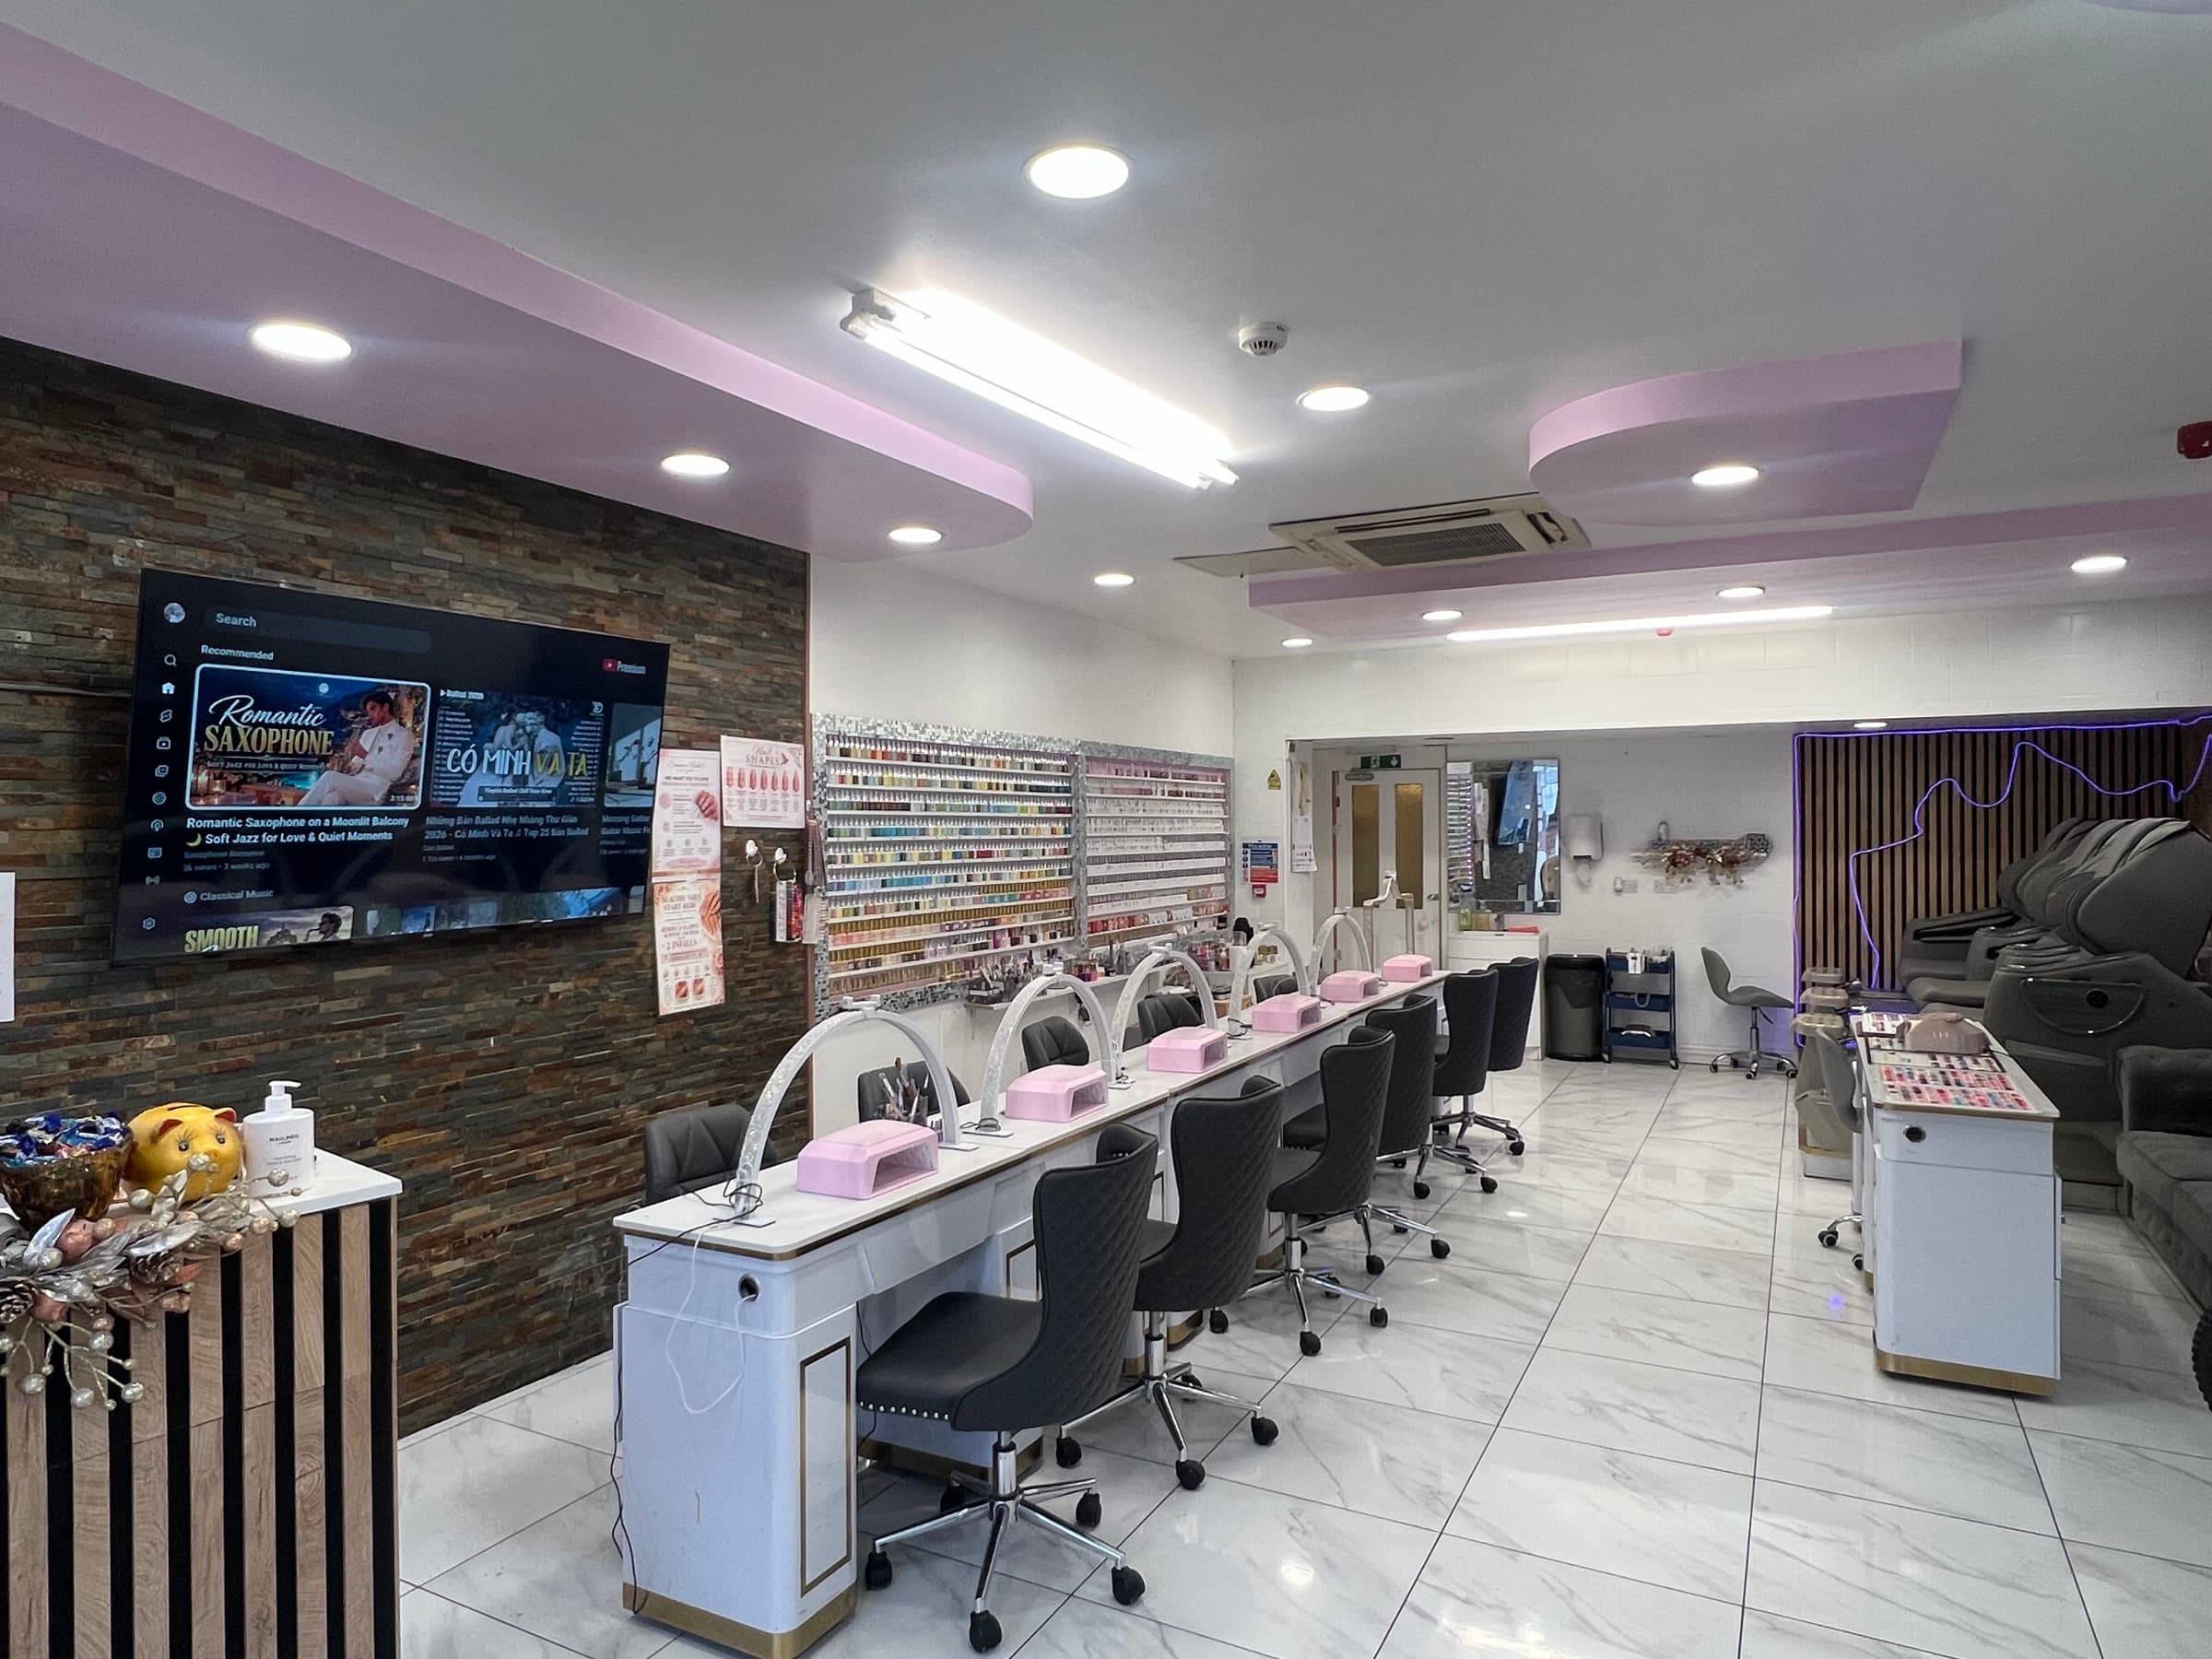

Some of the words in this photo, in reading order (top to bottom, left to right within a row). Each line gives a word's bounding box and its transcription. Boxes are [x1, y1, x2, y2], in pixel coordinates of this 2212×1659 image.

[215, 612, 257, 628] Search
[201, 644, 274, 661] Recommended
[209, 694, 327, 726] Romantic
[204, 724, 335, 756] SAXOPHONE
[447, 743, 478, 773] CÓ
[567, 751, 588, 776] TA
[187, 818, 243, 829] Romantic
[245, 817, 306, 830] Saxophone
[308, 818, 322, 827] on
[324, 818, 330, 827] a
[332, 816, 371, 827] Moonlit
[372, 816, 410, 828] Balcony
[206, 833, 229, 844] Soft
[232, 834, 259, 843] Jazz
[262, 832, 277, 842] for
[280, 832, 306, 842] Love
[308, 832, 316, 841] &
[318, 831, 346, 842] Quiet
[347, 831, 394, 841] Moments
[199, 889, 244, 901] Classical
[245, 888, 275, 899] Music
[184, 924, 259, 953] SMOOTH
